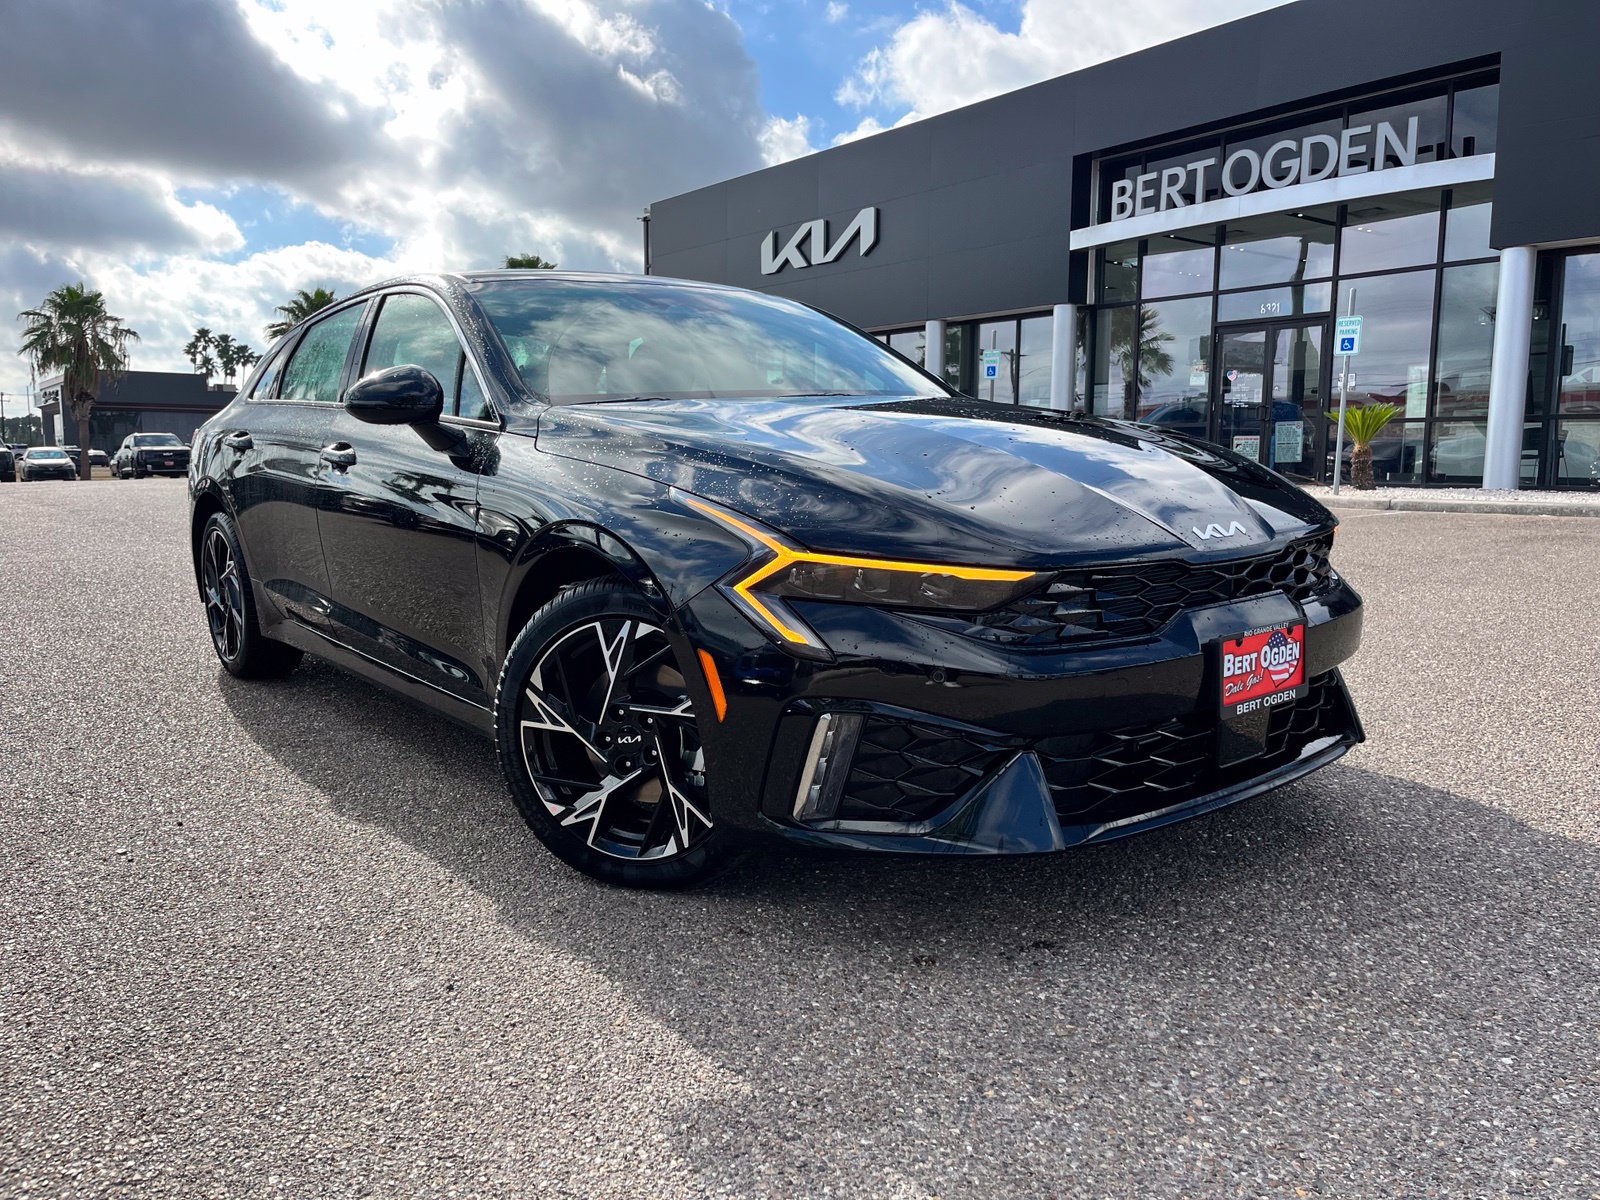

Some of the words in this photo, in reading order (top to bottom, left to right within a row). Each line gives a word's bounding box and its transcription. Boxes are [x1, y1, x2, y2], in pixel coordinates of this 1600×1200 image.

[1111, 157, 1216, 222] BERT
[1221, 115, 1419, 198] OGDEN
[760, 206, 876, 275] KIA
[1337, 319, 1361, 327] RESERVED
[1192, 520, 1247, 540] KIA
[1243, 629, 1253, 638] RIO
[1253, 625, 1272, 636] GRANDE
[1273, 621, 1290, 632] VALLEY
[1223, 652, 1258, 678] BERT
[1260, 641, 1300, 669] OGDEN
[1225, 680, 1245, 697] Dale
[1236, 699, 1262, 715] BERT
[1263, 689, 1296, 707] OGDEN
[617, 734, 642, 744] KIA
